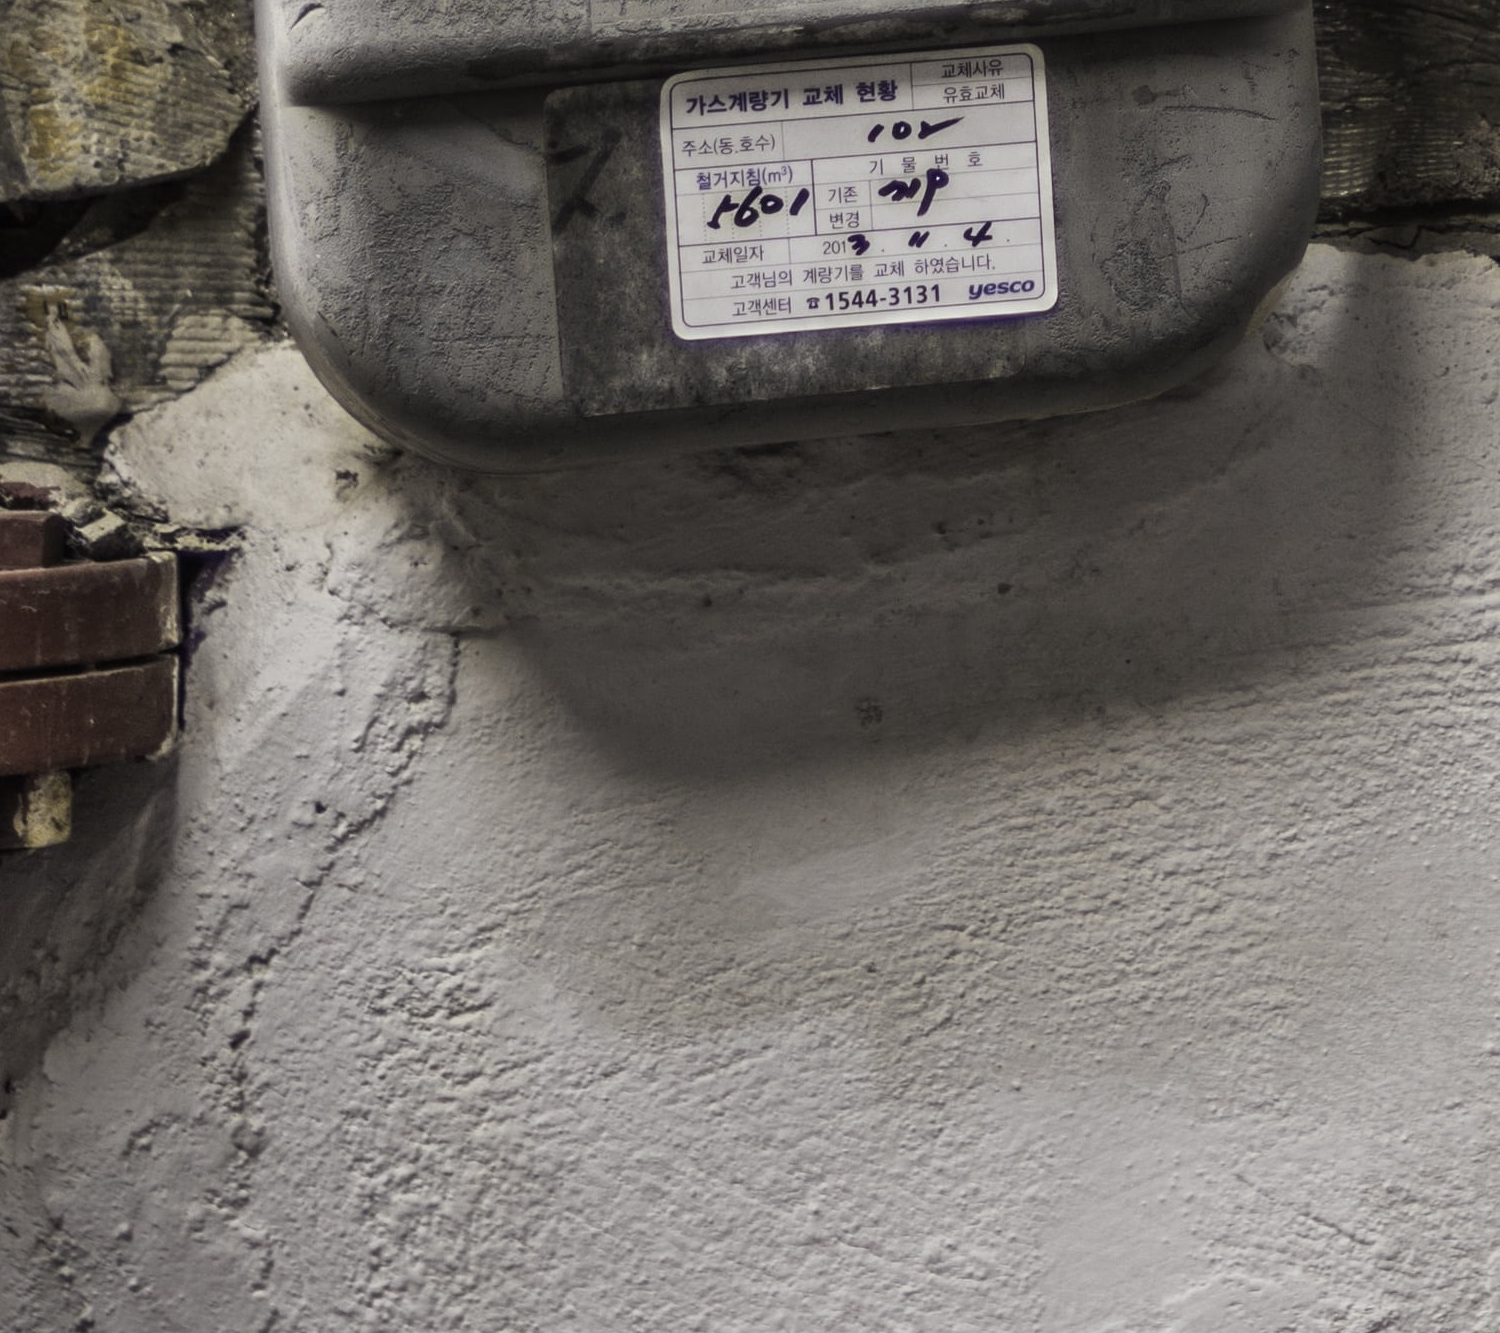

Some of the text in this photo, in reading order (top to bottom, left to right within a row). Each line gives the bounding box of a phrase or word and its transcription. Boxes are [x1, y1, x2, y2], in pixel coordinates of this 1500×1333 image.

[941, 59, 1004, 79] 교체사유
[686, 80, 899, 116] 가스계량기 교체 현황
[943, 84, 1006, 104] 유효교체
[828, 184, 860, 204] 기존
[829, 210, 861, 230] 변경
[702, 245, 765, 265] 교체일자
[731, 252, 997, 291] 고객님의 계량기를 교체 하였습니다.
[969, 278, 1036, 301] yesco
[732, 283, 942, 318] 고객센터 1544-3131
